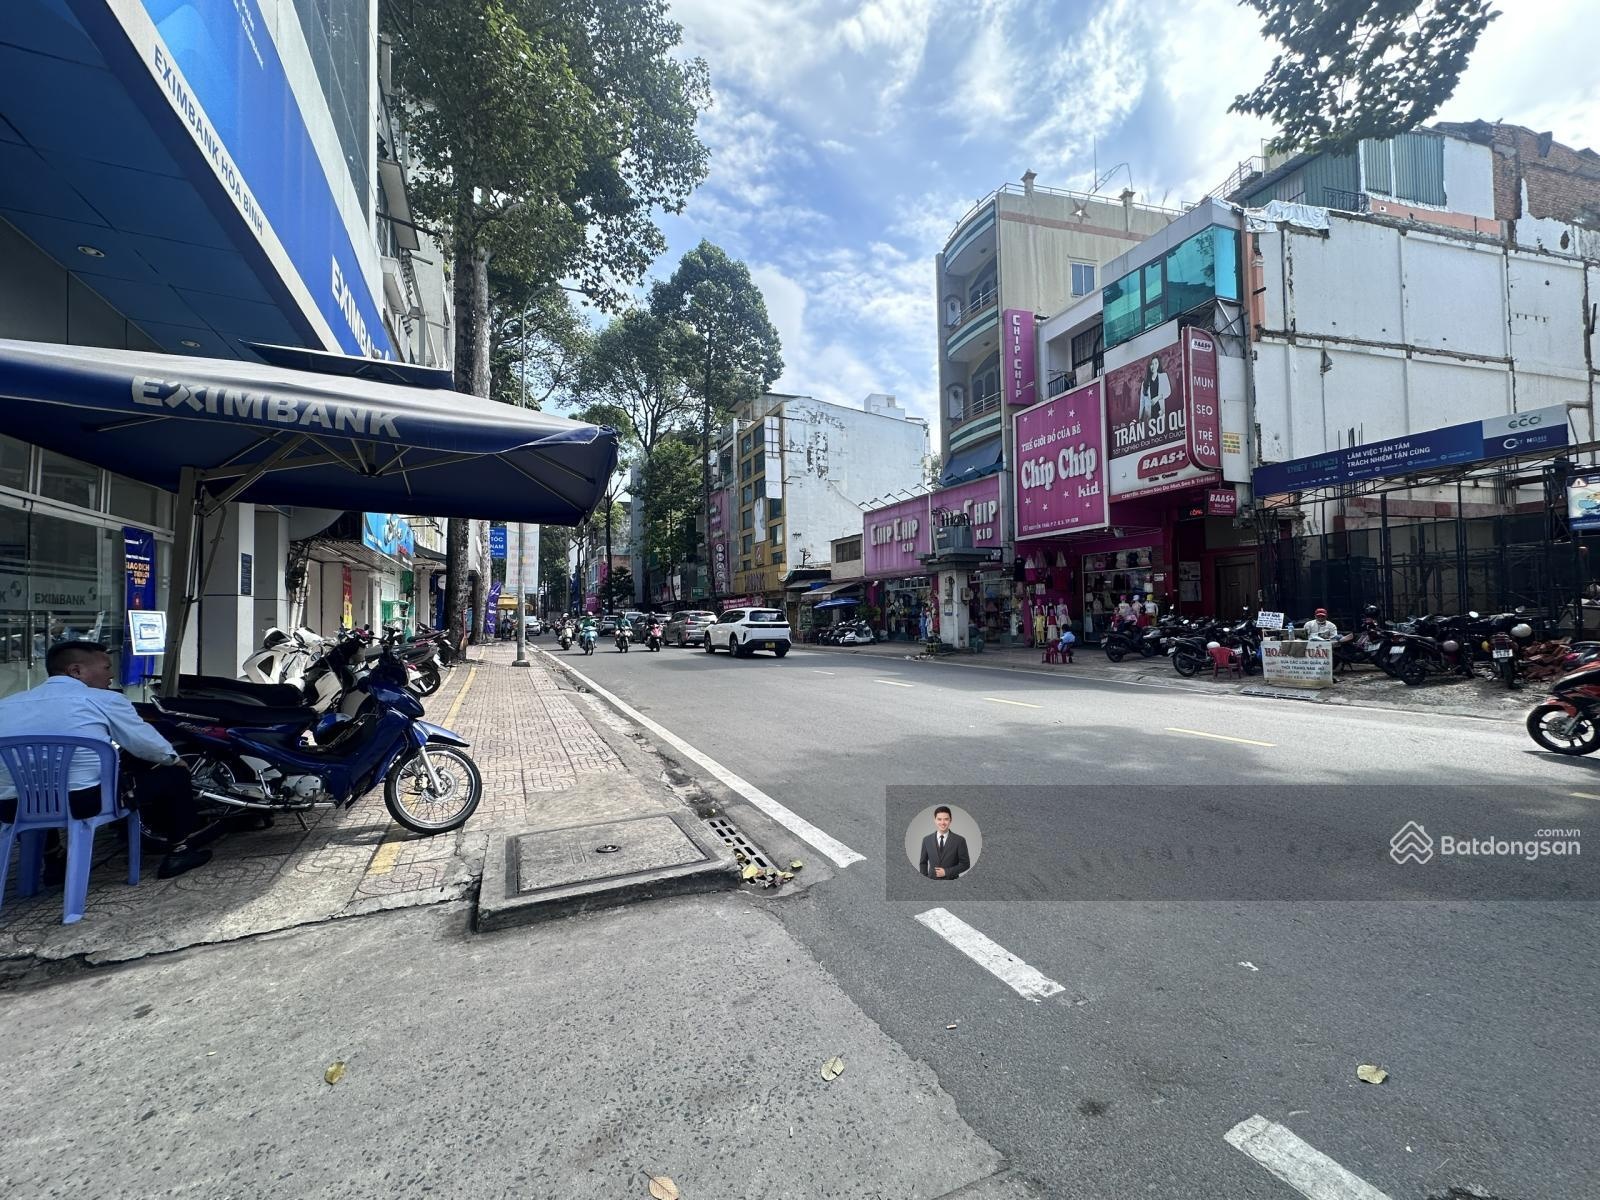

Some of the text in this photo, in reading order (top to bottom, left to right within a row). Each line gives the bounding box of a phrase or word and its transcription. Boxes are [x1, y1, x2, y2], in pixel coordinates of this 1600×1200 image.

[155, 44, 263, 236] EXIMBANK HÒA BÌNH
[1012, 314, 1022, 398] CHIP CHIP
[1193, 376, 1214, 390] MỤN
[131, 376, 400, 438] EXIMBANK
[1196, 404, 1213, 417] SẸO
[1114, 419, 1145, 447] TRẦN
[1198, 427, 1213, 441] TRẺ
[1196, 443, 1217, 457] HÓA
[1347, 459, 1369, 468] TRÁCH
[1370, 454, 1392, 464] NHIỆM
[1409, 446, 1431, 456] CÙNG
[1362, 448, 1378, 457] VIỆC
[1021, 443, 1098, 491] Chip Chip
[1142, 450, 1186, 470] BAAS+
[1078, 481, 1100, 498] kid
[1209, 494, 1235, 503] BAAS+
[870, 523, 893, 546] CHIP
[893, 518, 920, 542] CHIP
[975, 527, 993, 541] KID
[901, 542, 914, 553] KID
[34, 592, 86, 606] EXIMBANK
